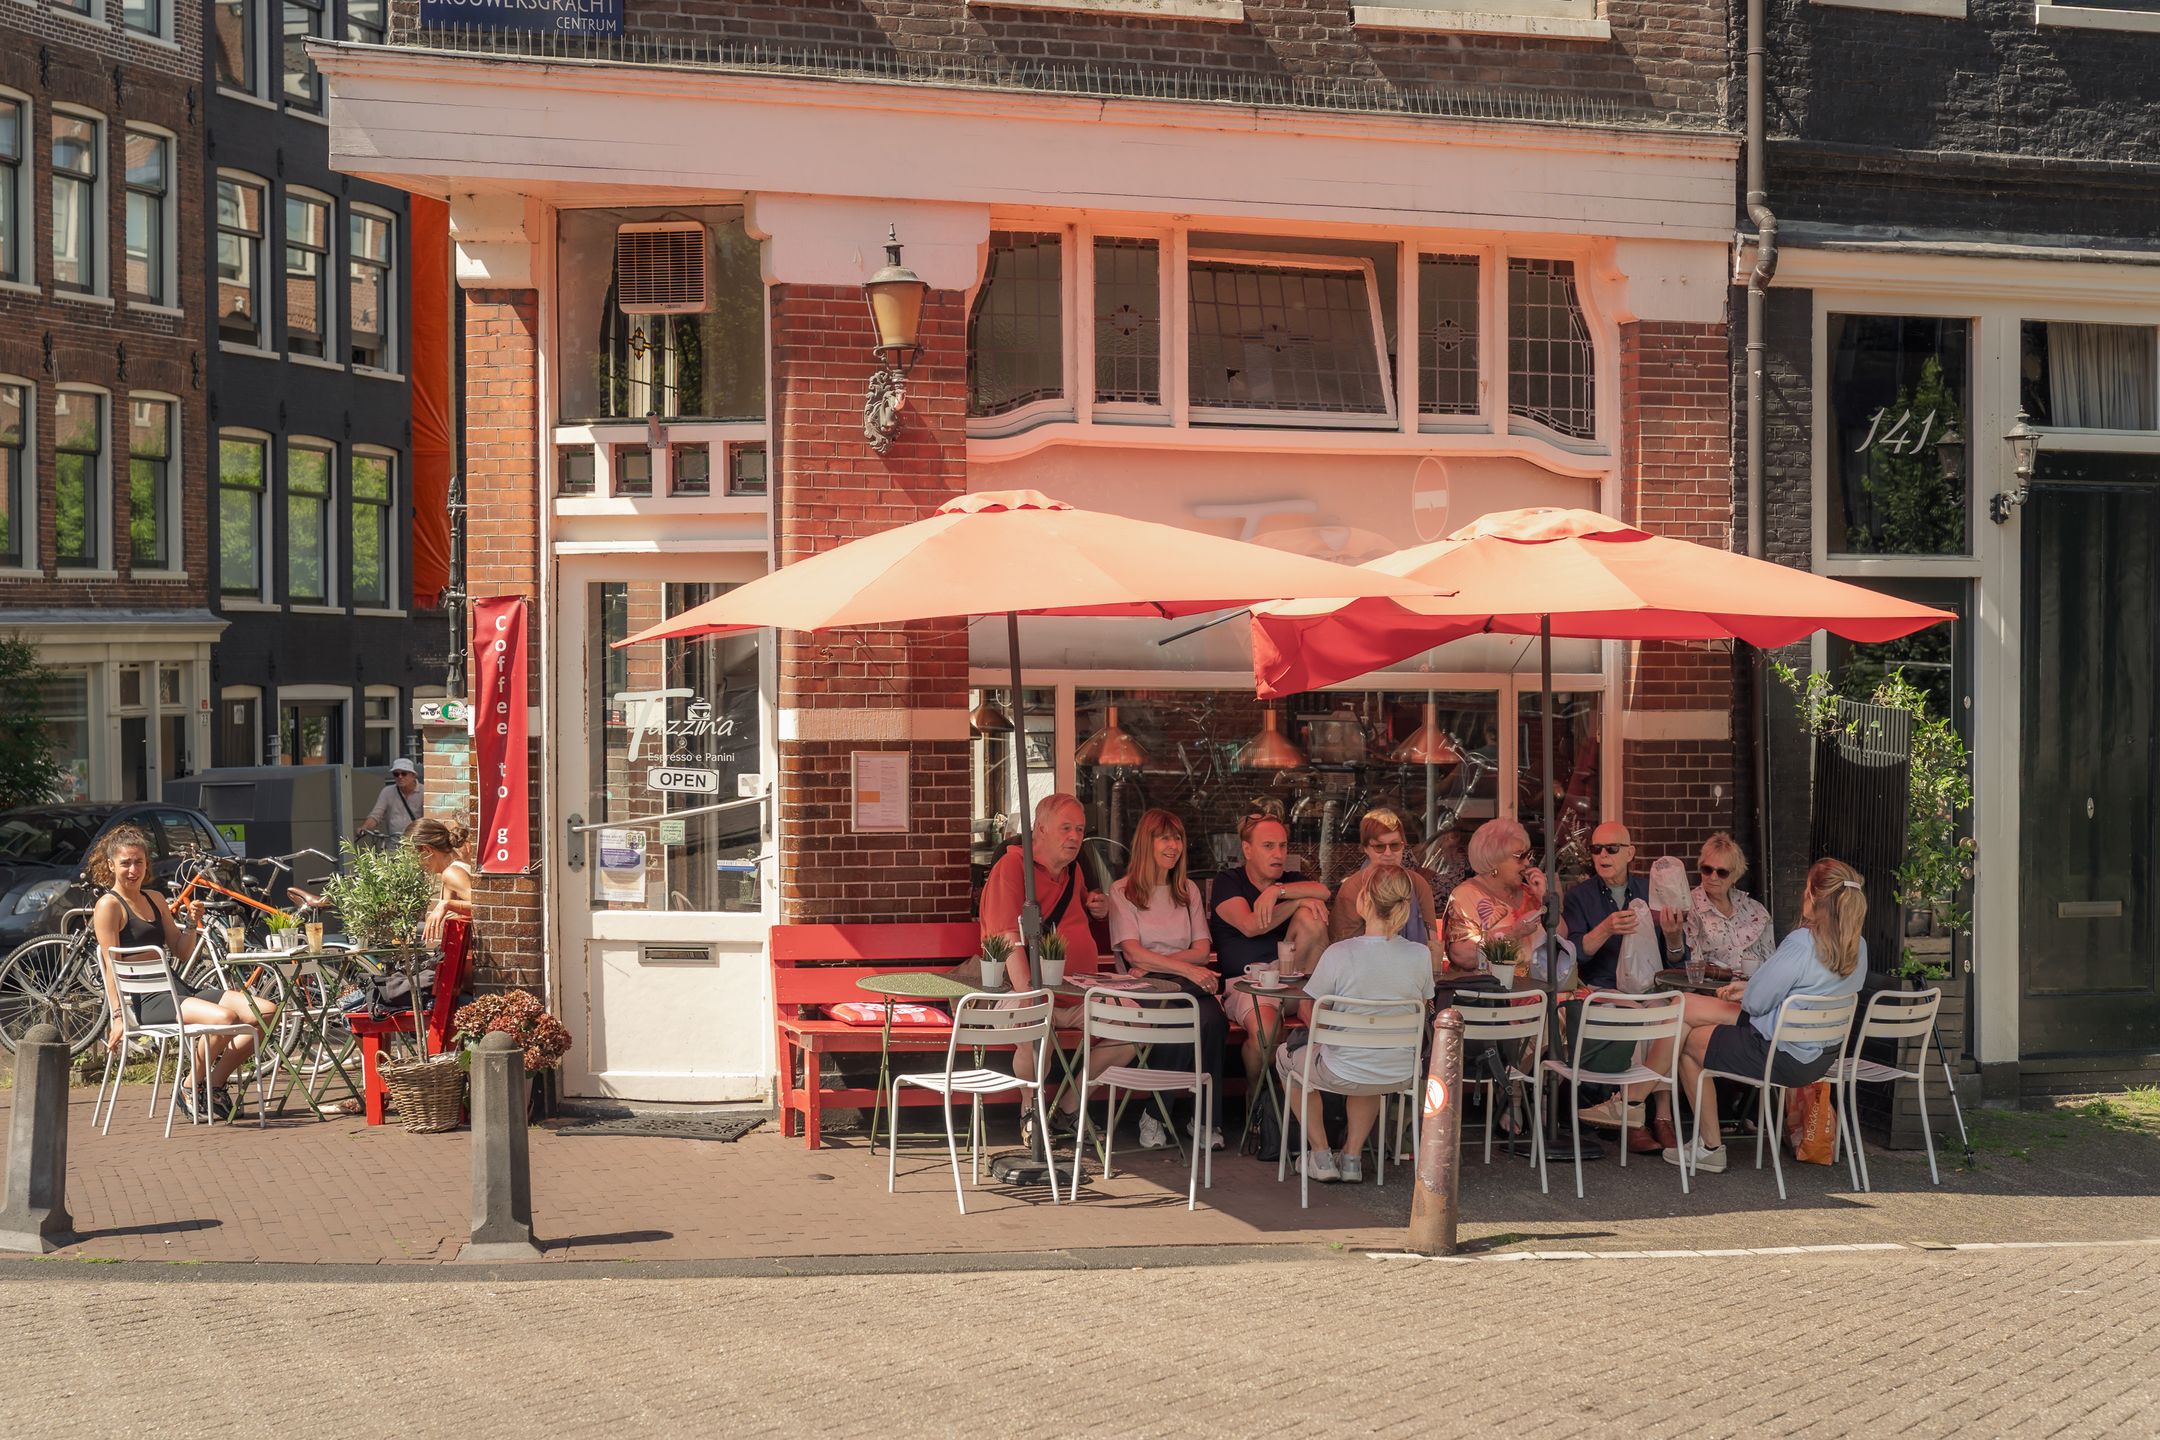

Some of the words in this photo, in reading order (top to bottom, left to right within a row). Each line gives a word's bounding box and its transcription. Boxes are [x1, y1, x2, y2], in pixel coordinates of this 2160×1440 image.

[427, 0, 613, 14] SGRACHT
[556, 16, 617, 32] CENTRUM
[1855, 407, 1936, 455] 141
[495, 615, 508, 736] Coffee
[613, 687, 735, 763] Tazzina
[648, 753, 693, 765] Espresso
[705, 753, 735, 762] Panini
[497, 762, 509, 799] to
[660, 772, 707, 788] OPEN
[497, 826, 509, 861] go
